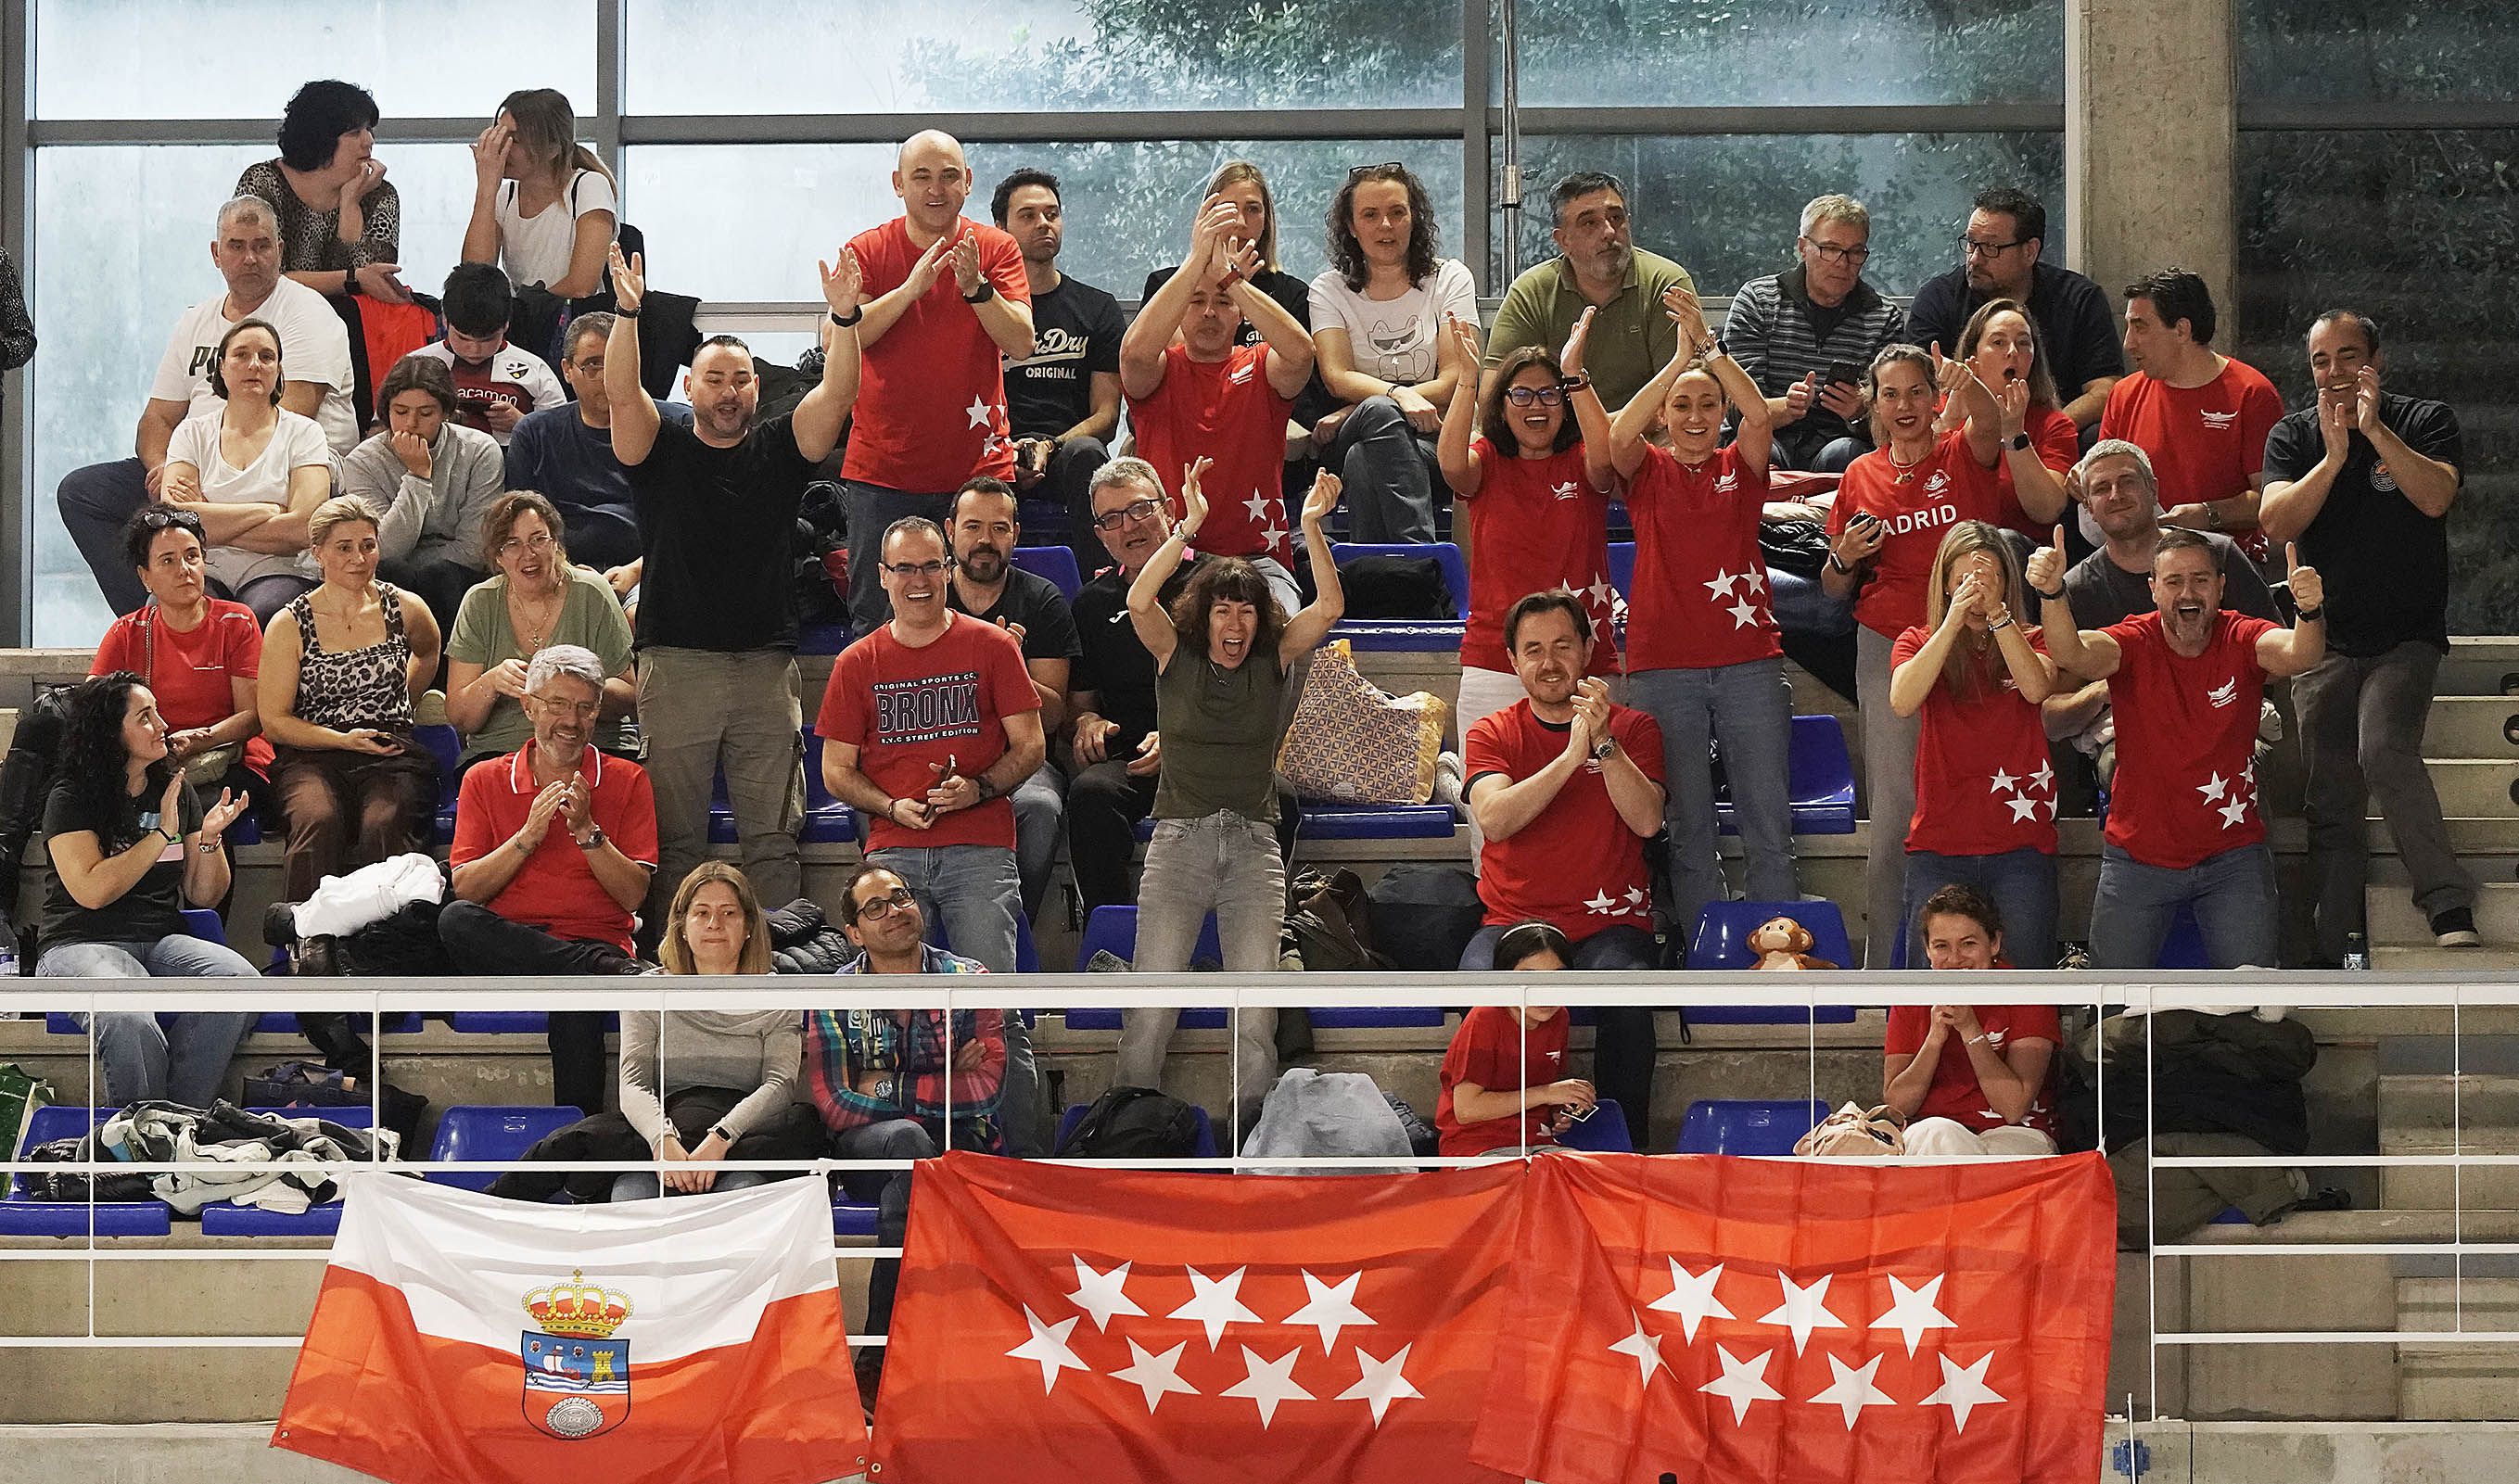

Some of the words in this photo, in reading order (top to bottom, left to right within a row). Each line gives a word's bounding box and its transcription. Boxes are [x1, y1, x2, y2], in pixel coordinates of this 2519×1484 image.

[1025, 366, 1076, 379] ORIGINAL
[1881, 504, 1957, 536] ADRID
[874, 681, 919, 691] ORIGINAL
[922, 675, 960, 684] SPORTS
[876, 683, 979, 733] BRONX
[905, 732, 939, 742] STREET
[941, 728, 978, 738] EDITION
